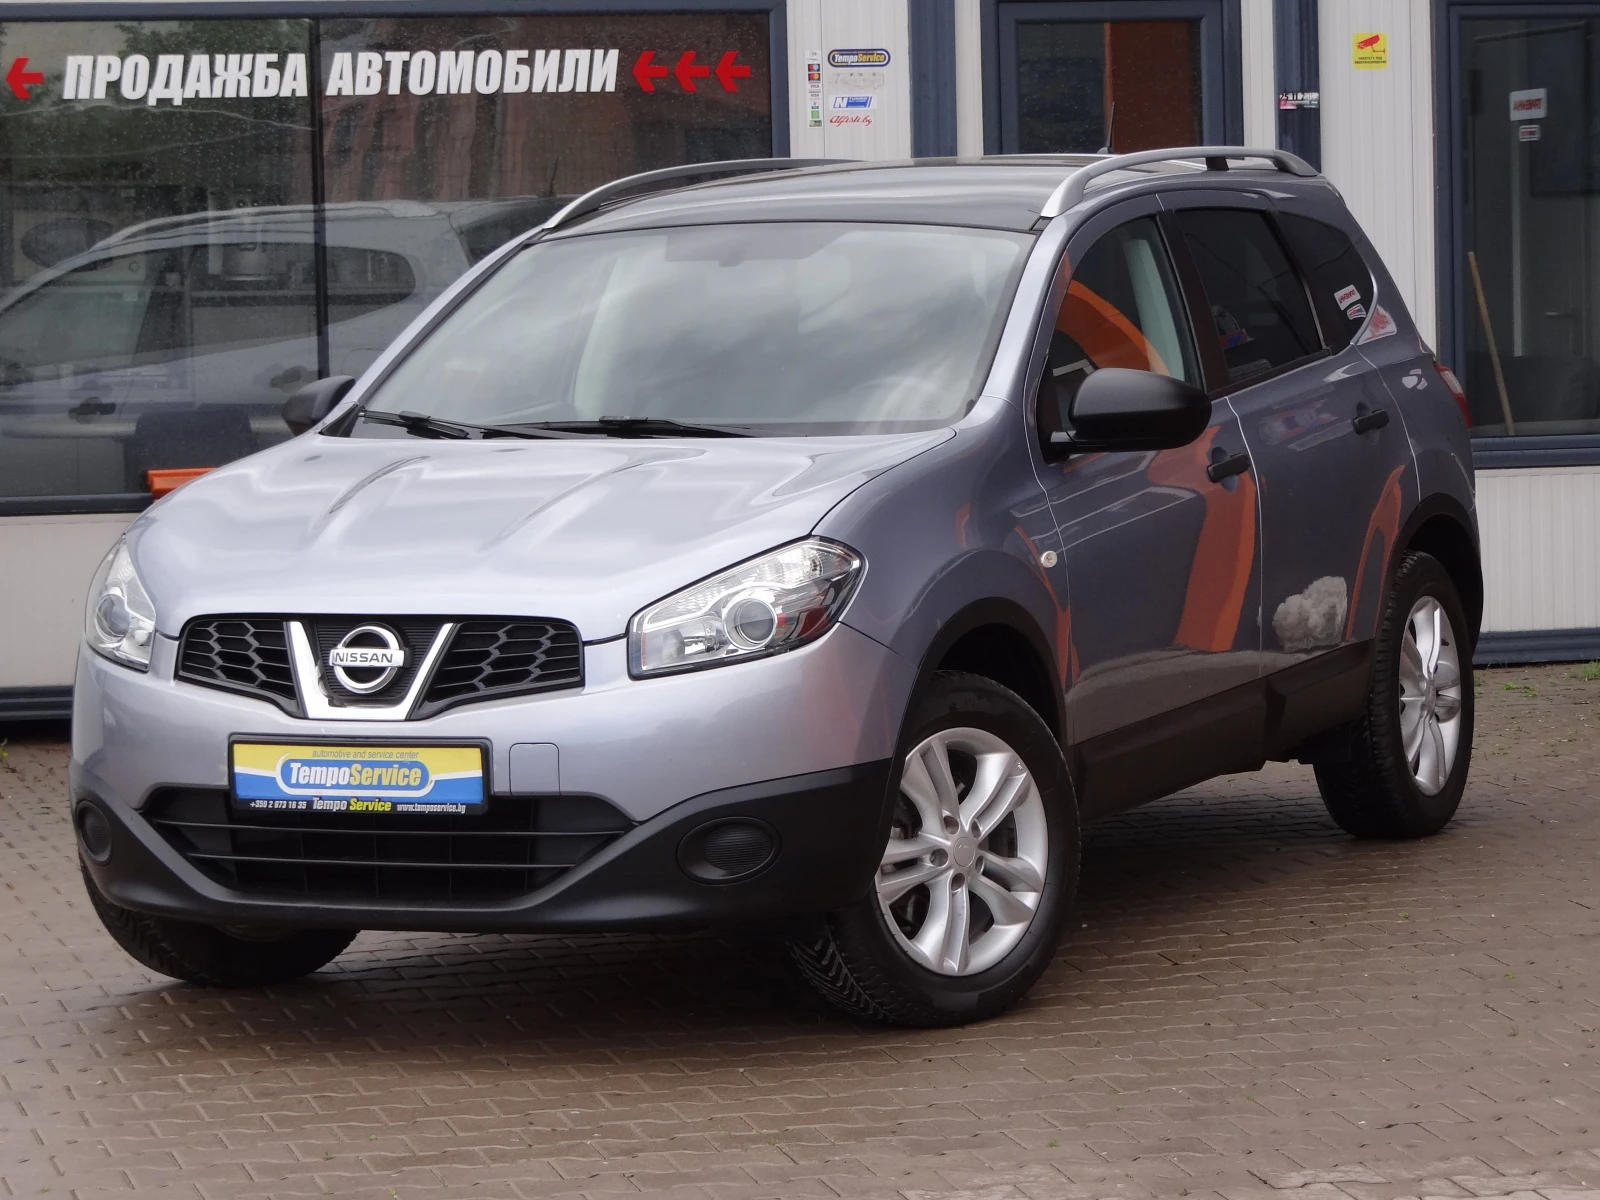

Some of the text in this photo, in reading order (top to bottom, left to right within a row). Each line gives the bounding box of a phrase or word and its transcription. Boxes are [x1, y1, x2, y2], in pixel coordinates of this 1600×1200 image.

[834, 51, 885, 65] TempoService
[62, 48, 619, 107] ПРОДАЖБА АВТОМОБИЛИ
[335, 652, 393, 664] NISSAN
[312, 749, 419, 760] automotive and service center
[290, 762, 422, 787] TempoService
[268, 800, 274, 809] 2
[312, 796, 348, 812] Tempo
[349, 797, 392, 812] Service
[396, 803, 467, 814] www.temposervice.bg
